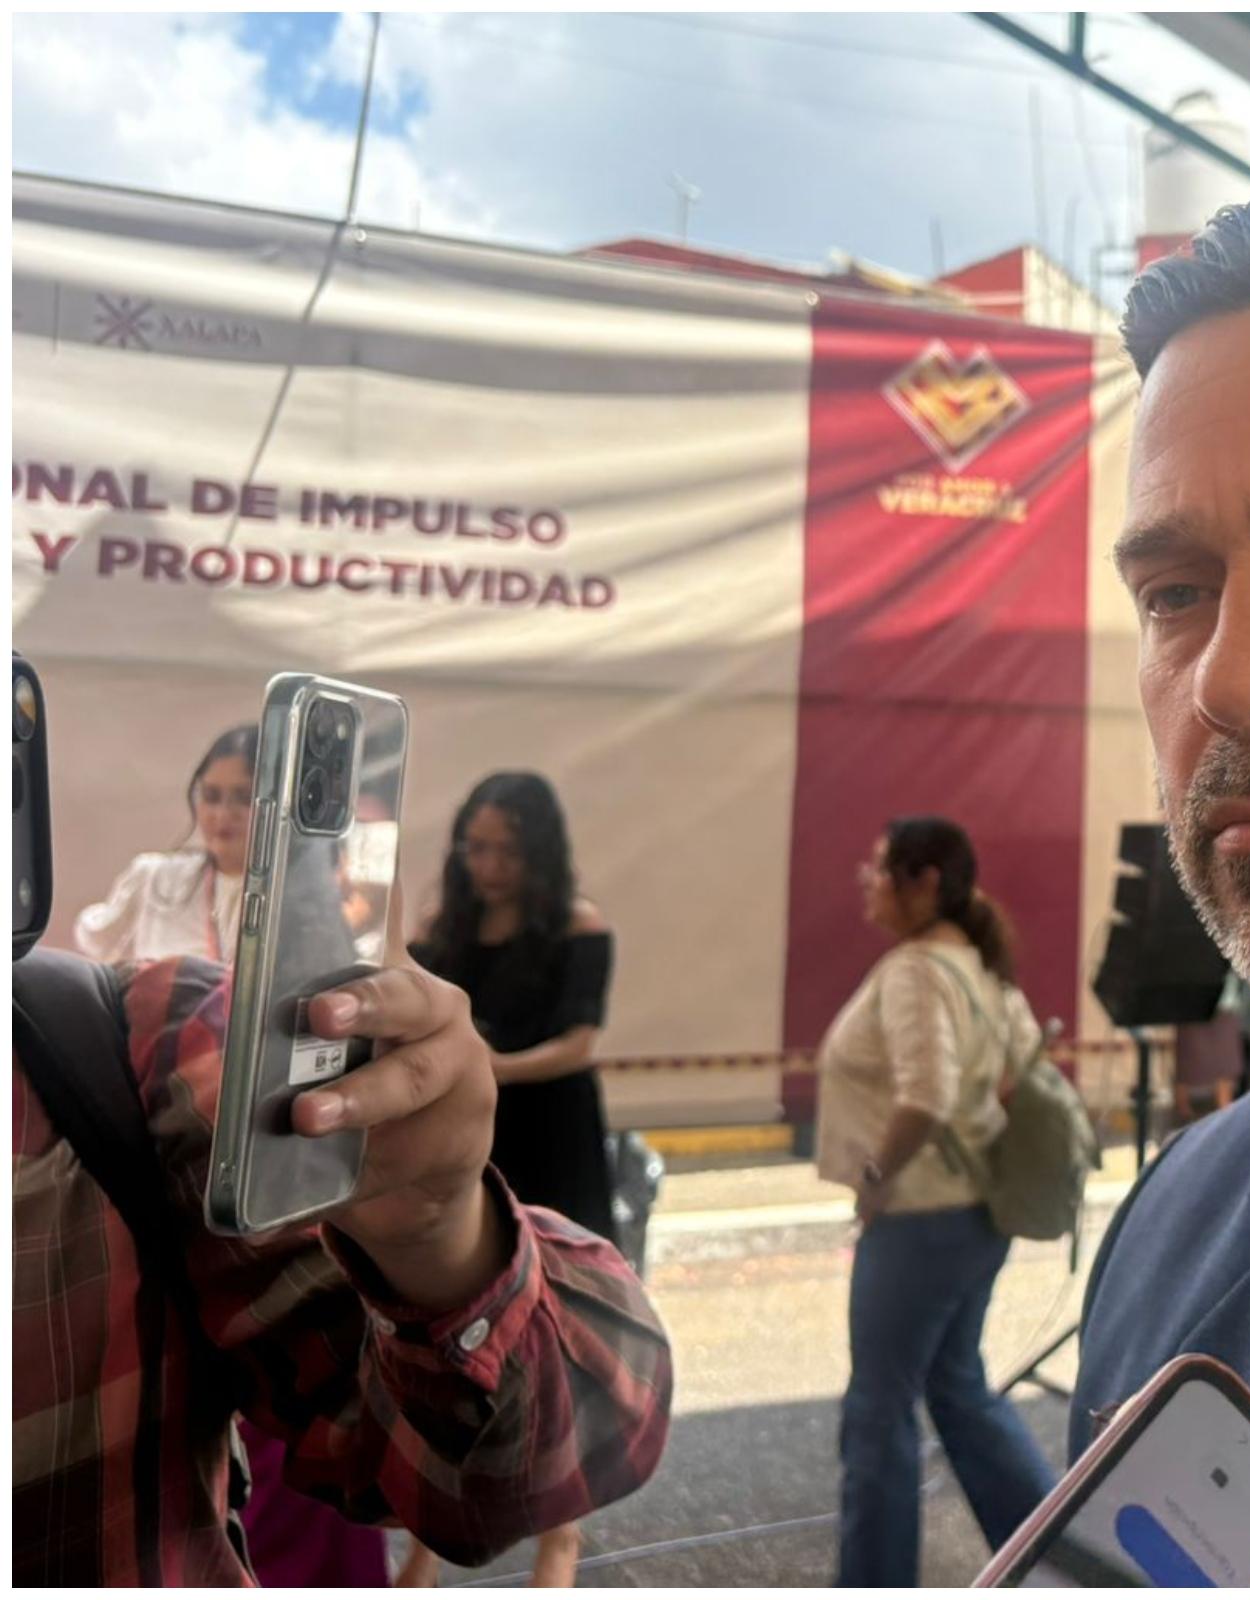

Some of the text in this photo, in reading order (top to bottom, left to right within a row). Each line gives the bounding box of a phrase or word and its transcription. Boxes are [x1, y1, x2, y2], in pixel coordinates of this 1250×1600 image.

[12, 463, 565, 544] NAL DE IMPULSO
[31, 532, 615, 608] Y PRODUCTIVIDAD
